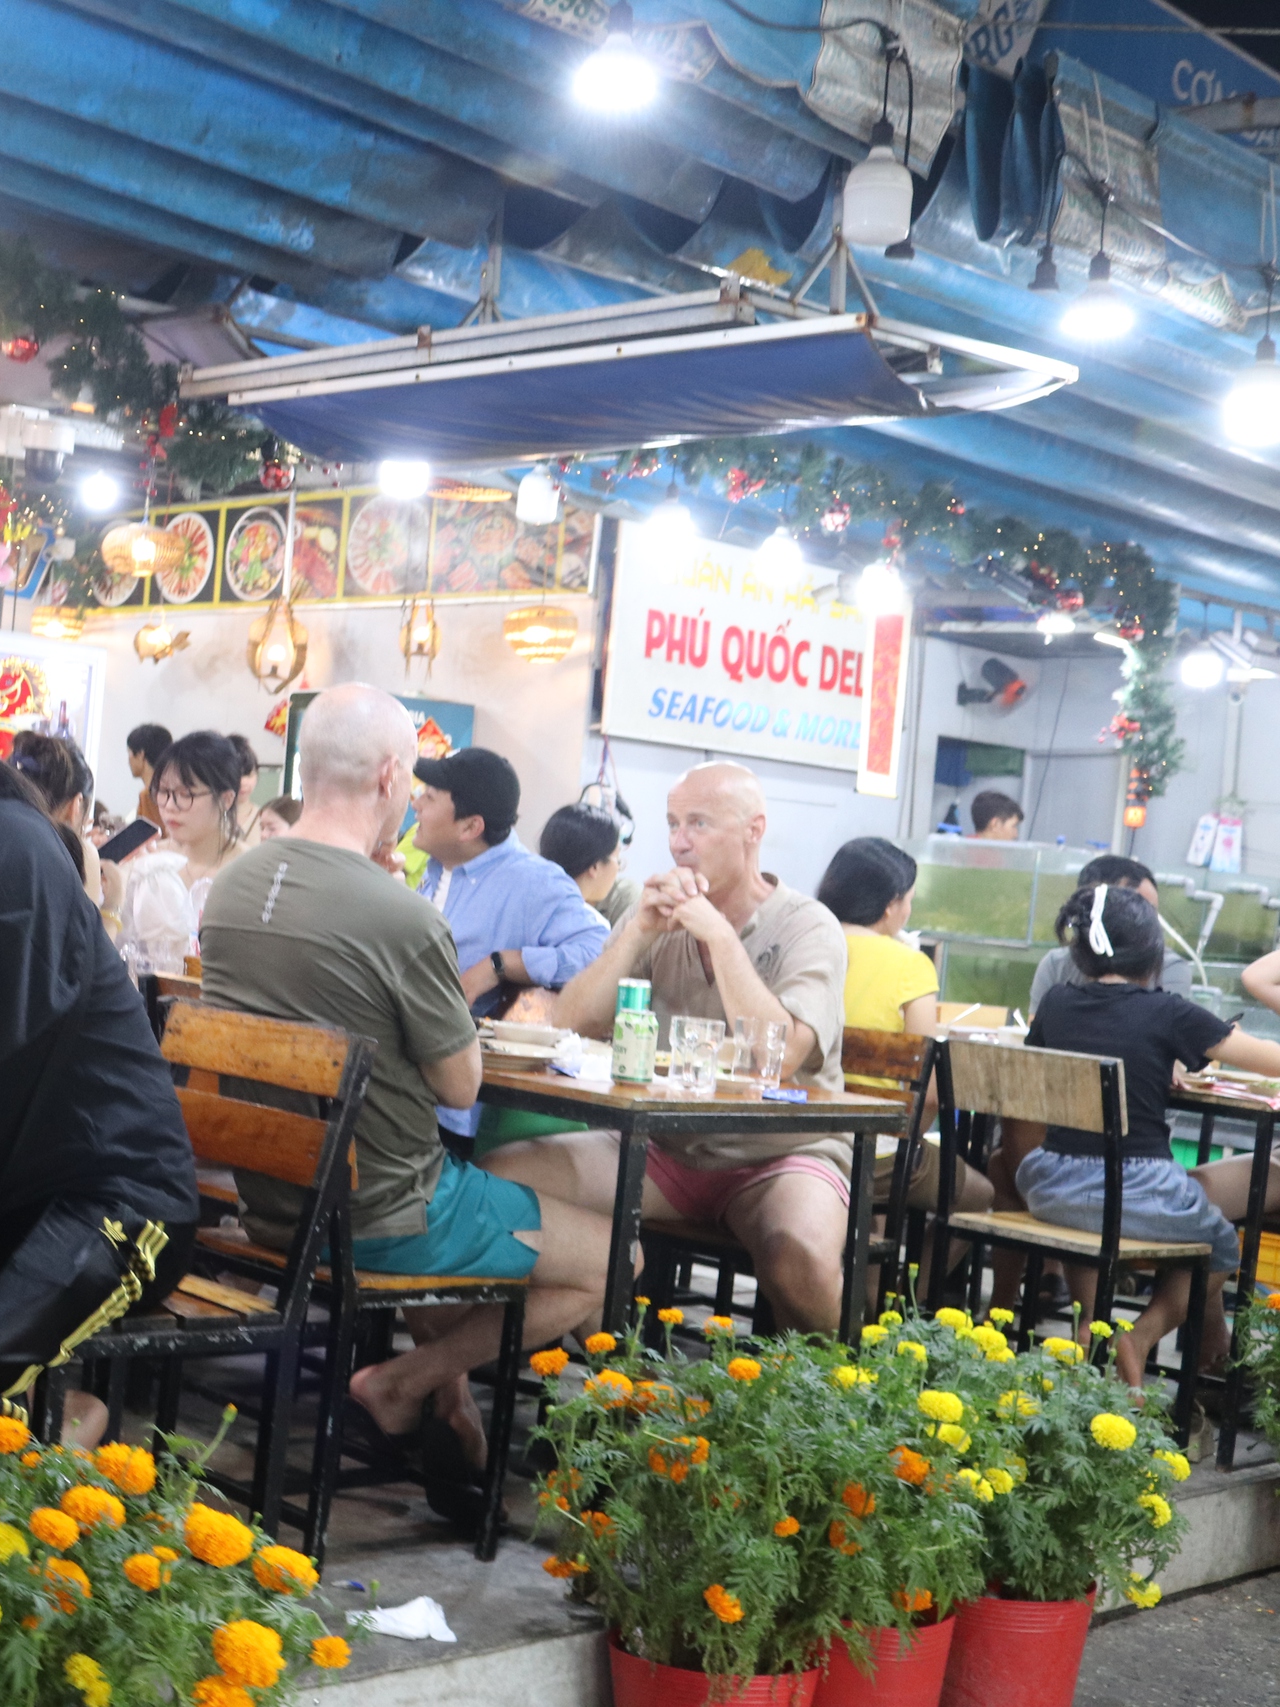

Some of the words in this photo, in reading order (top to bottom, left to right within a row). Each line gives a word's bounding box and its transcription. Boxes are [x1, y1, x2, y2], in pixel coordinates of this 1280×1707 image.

[644, 607, 711, 669] PHÚ
[721, 618, 811, 688] QUỐC
[818, 643, 863, 698] DEL
[648, 687, 771, 734] SEAFOOD
[772, 708, 792, 738] &
[794, 711, 862, 750] MORE
